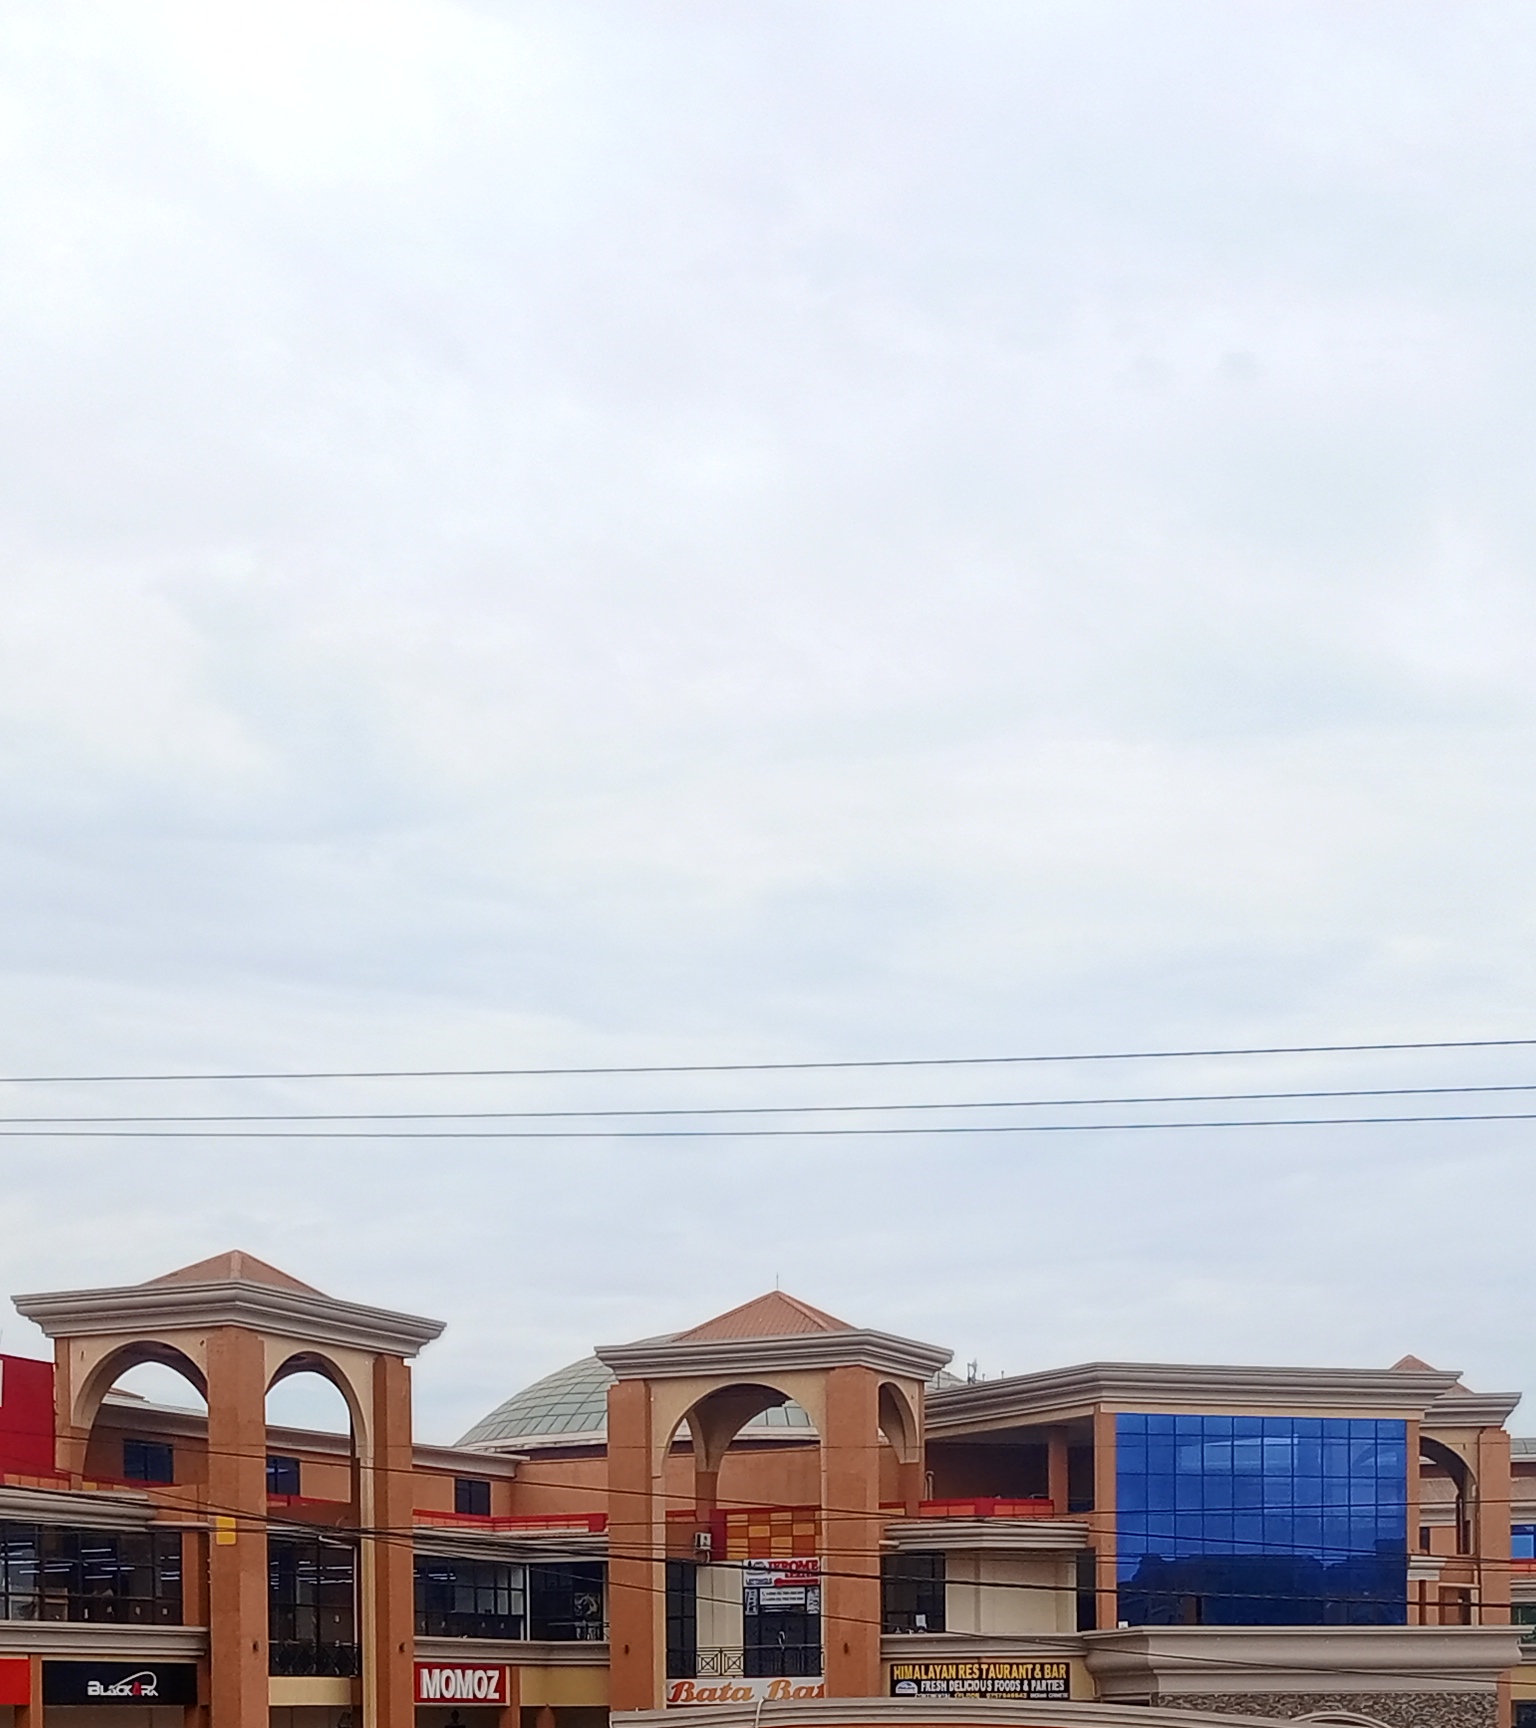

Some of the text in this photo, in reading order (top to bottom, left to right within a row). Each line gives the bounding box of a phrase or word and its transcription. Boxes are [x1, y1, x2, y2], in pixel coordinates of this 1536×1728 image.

[894, 1665, 956, 1680] HIMALAYAN
[1033, 1664, 1042, 1678] &
[1044, 1664, 1066, 1679] BAR
[419, 1668, 499, 1699] MOMOZ
[667, 1681, 754, 1702] Bata
[920, 1680, 1065, 1692] FRESH DELICIOUS FOODS & PARTIES
